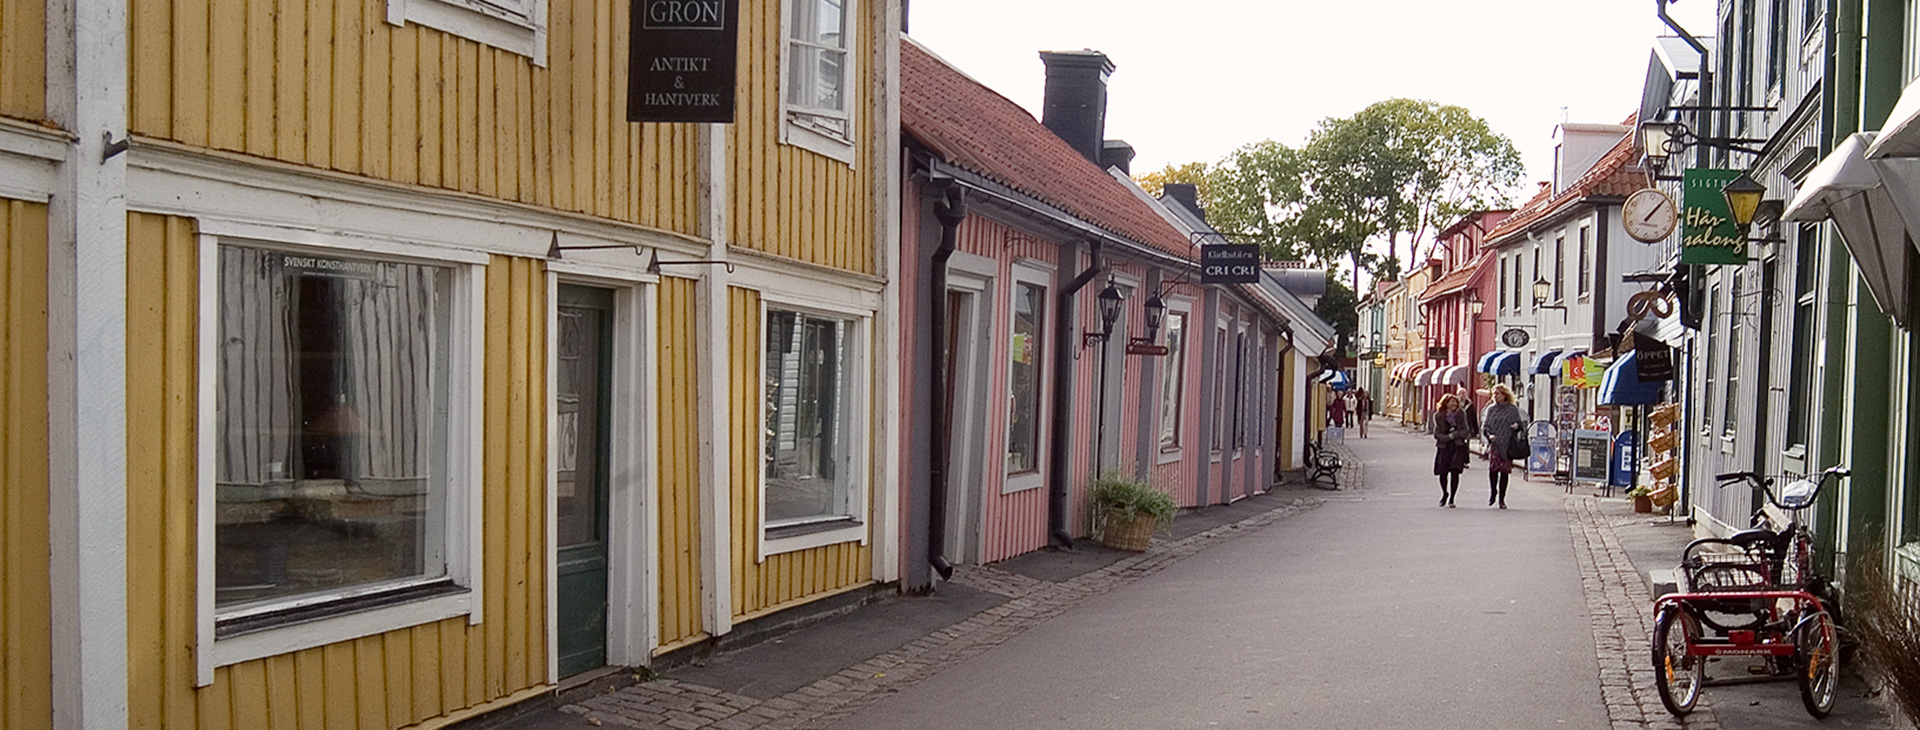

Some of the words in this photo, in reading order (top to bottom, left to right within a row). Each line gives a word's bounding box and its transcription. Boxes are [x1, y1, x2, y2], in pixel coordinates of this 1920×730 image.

[650, 57, 711, 72] ANTIKT
[673, 75, 686, 89] &
[644, 93, 720, 107] HANTVERK
[1691, 178, 1733, 188] SIGTU
[1686, 206, 1727, 228] Hår-
[1684, 226, 1745, 254] salong
[284, 256, 315, 267] SVENSKT
[1205, 265, 1229, 276] CRI
[1232, 265, 1255, 276] CRI
